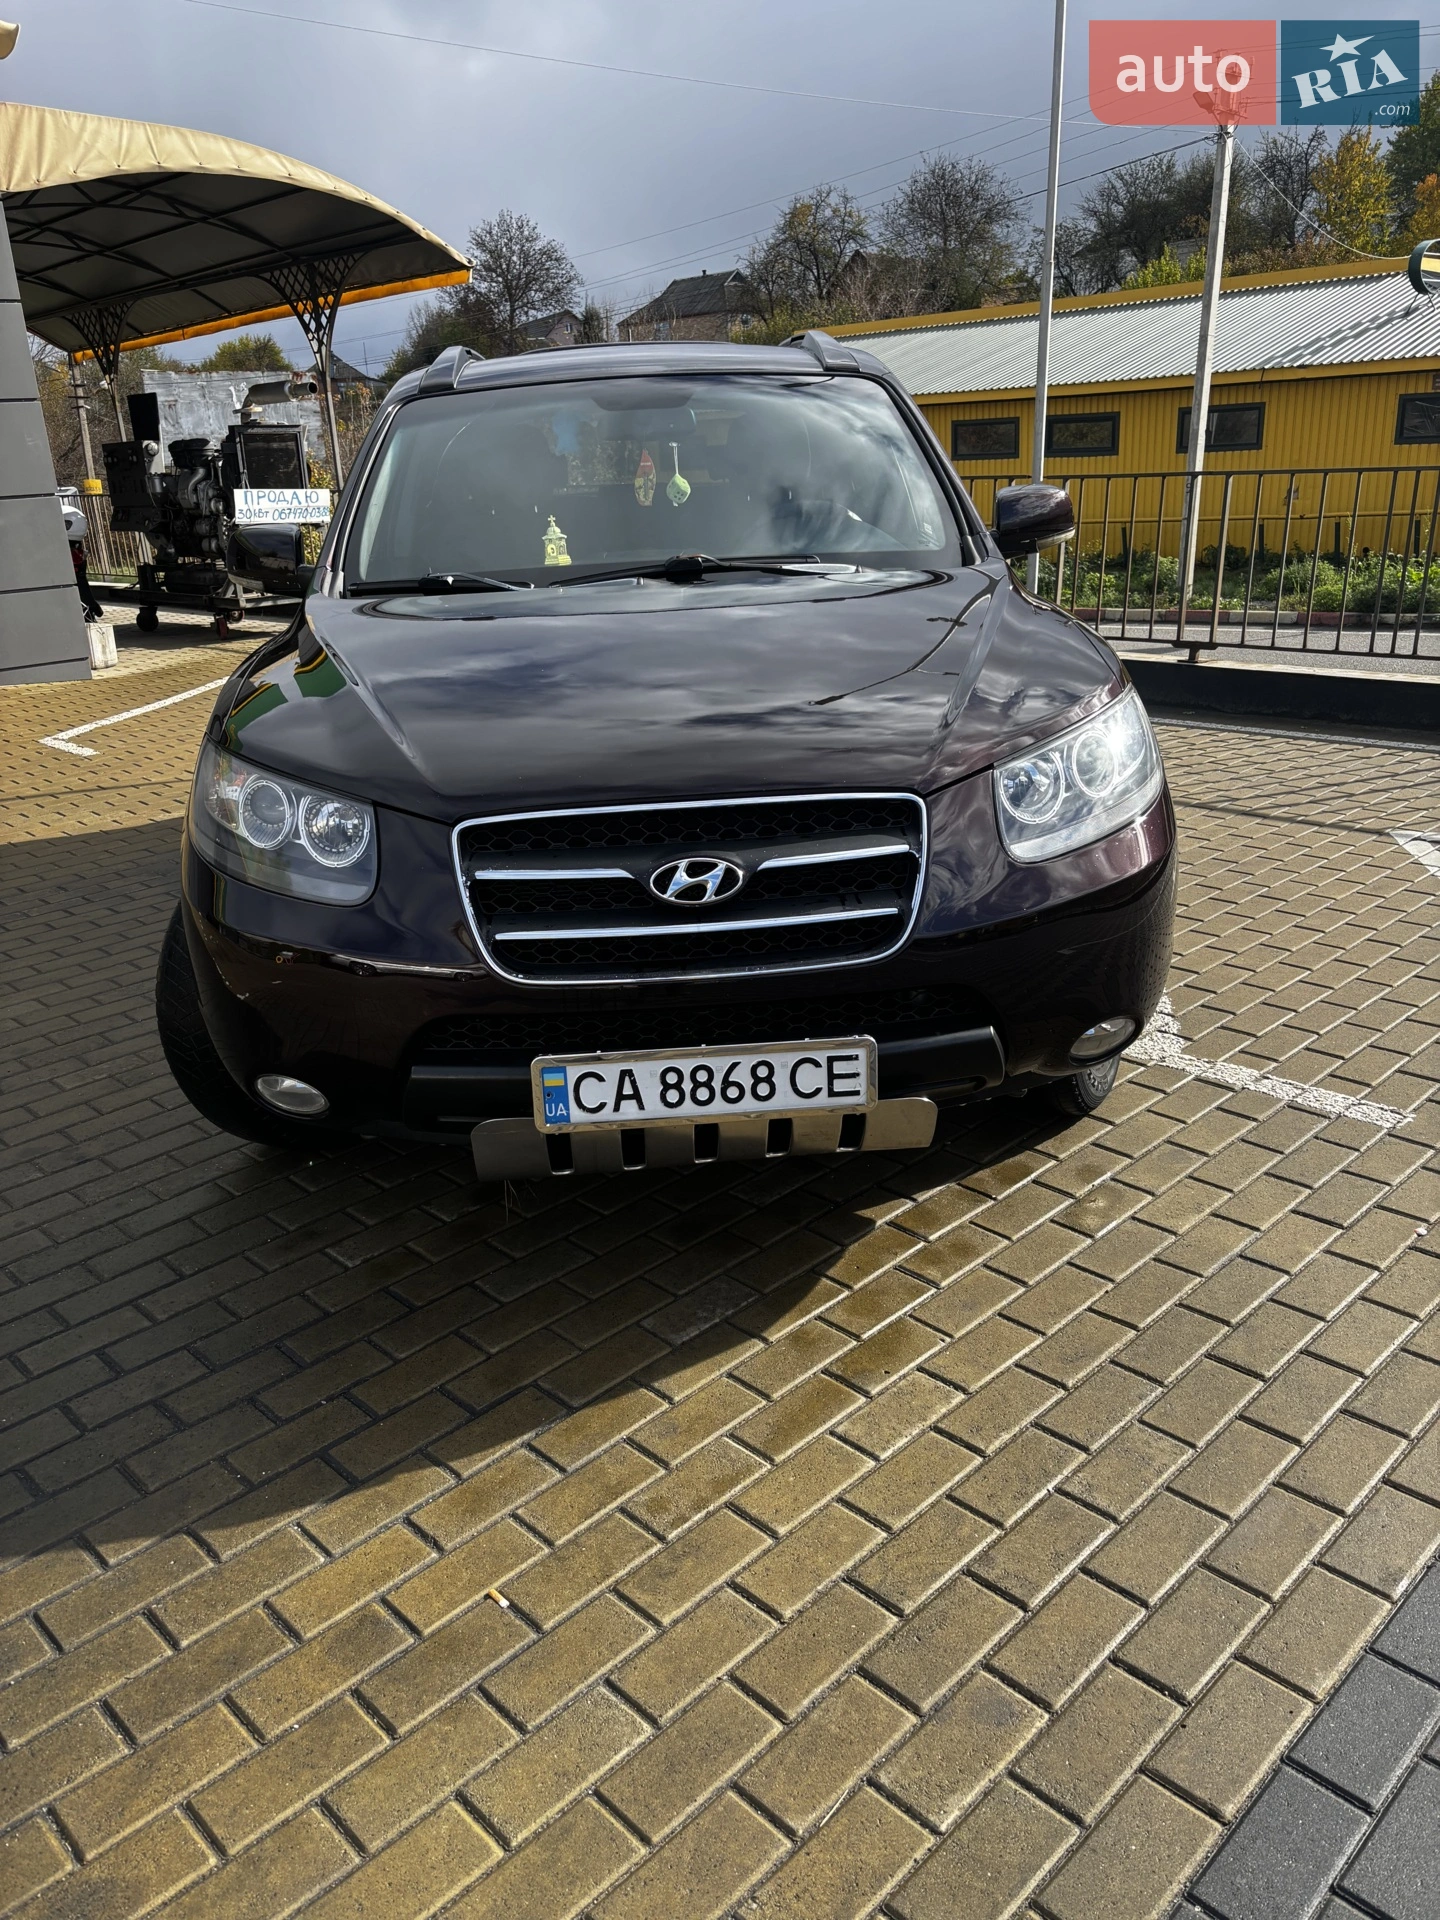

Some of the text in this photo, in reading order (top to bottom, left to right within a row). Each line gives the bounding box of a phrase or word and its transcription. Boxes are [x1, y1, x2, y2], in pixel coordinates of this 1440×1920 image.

[243, 490, 319, 506] ПРОДАЮ
[545, 1054, 861, 1117] UA CA 8868 CE
